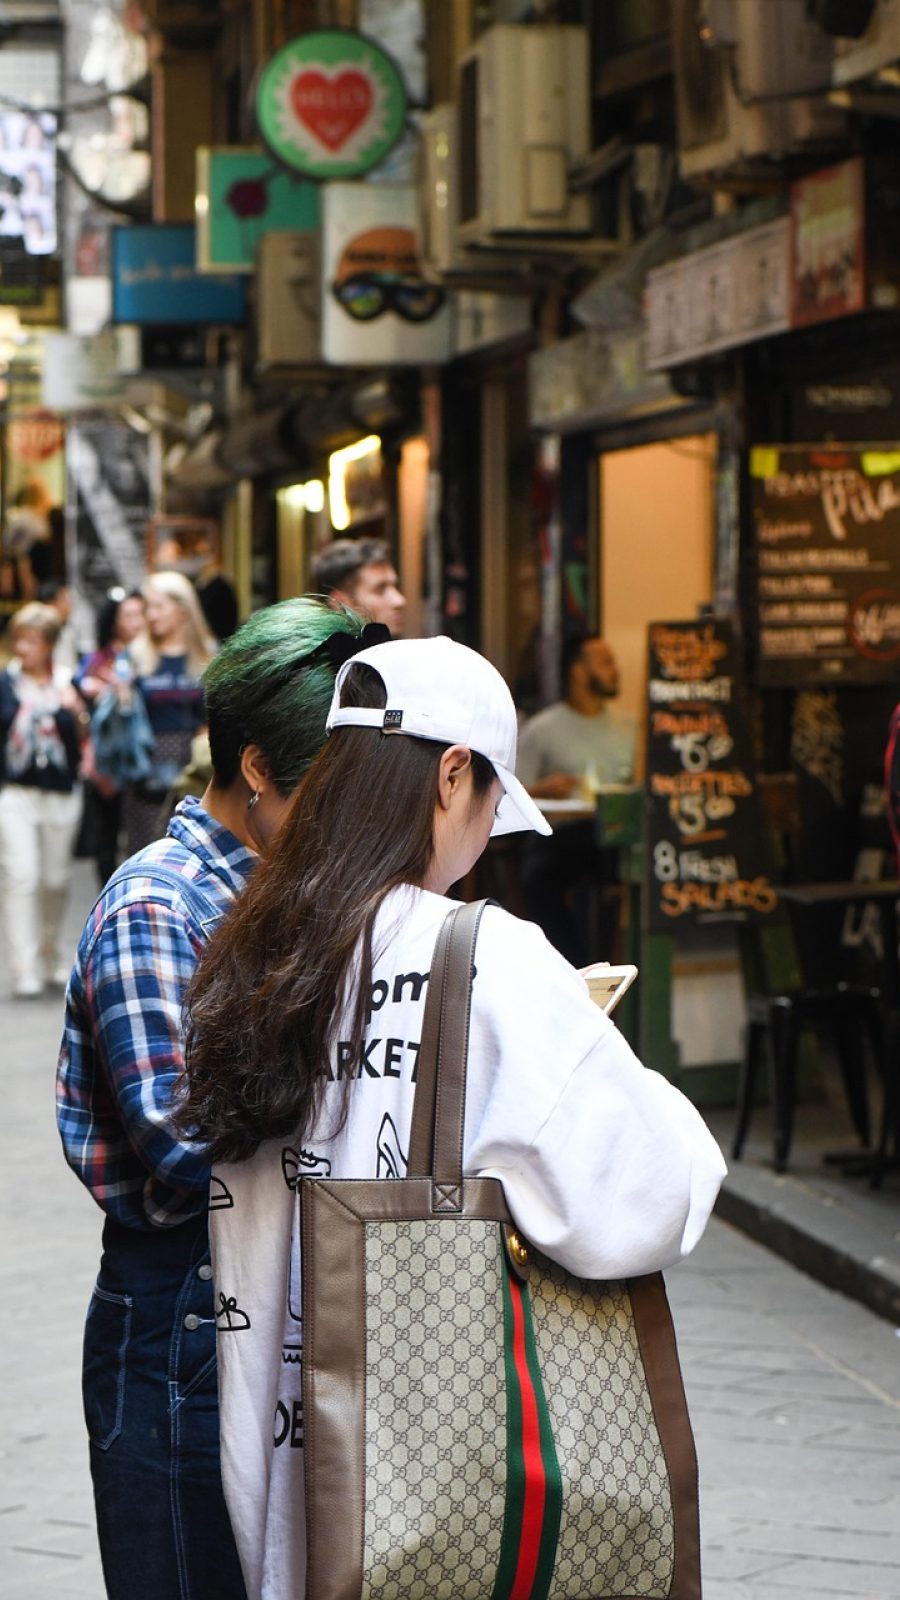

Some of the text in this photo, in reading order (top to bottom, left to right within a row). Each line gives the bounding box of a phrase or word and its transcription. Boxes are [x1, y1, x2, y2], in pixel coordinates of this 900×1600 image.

[653, 840, 680, 882] 8
[660, 876, 778, 917] SALADS
[319, 1037, 421, 1083] ARKET
